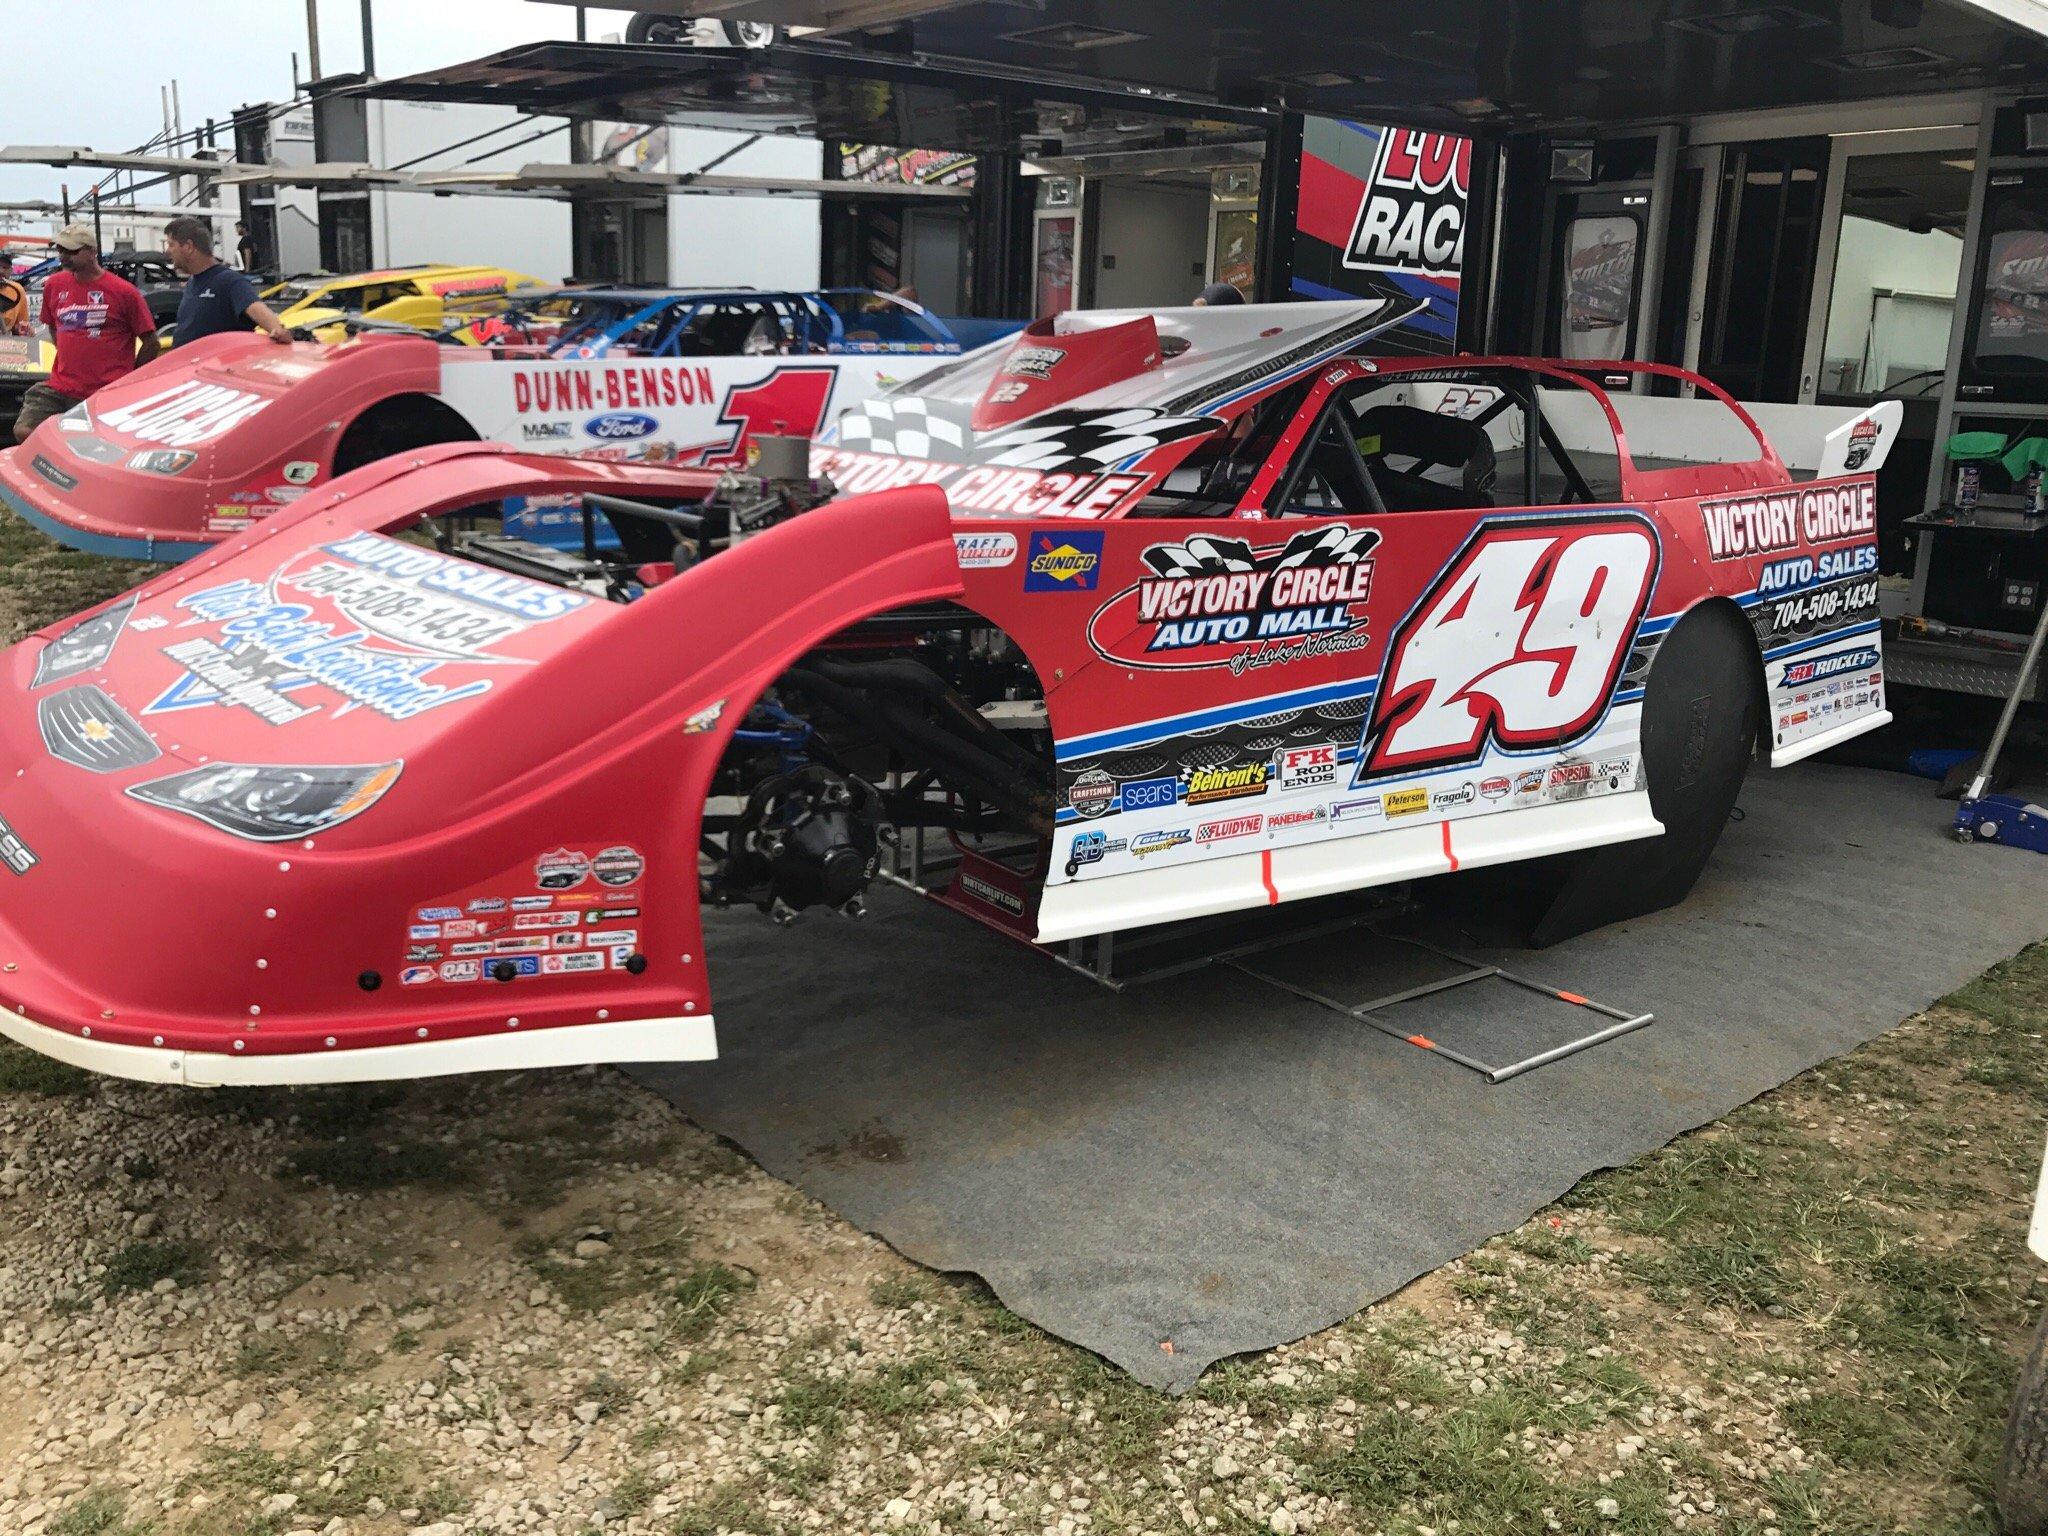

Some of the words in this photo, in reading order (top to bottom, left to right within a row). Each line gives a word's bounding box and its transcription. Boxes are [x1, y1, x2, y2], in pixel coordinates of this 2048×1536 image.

[1355, 196, 1464, 268] RAC
[514, 366, 716, 413] DUNN-BENSON
[97, 380, 275, 447] LUCAS
[596, 413, 647, 438] Ford
[944, 467, 1140, 520] CIRCLE
[1703, 497, 1798, 558] VICTORY
[1803, 484, 1874, 542] CIRCLE
[330, 532, 444, 579] AUTO
[424, 563, 588, 618] SALES
[1034, 554, 1095, 571] SUNOCO
[1759, 557, 1813, 593] AUTO
[1818, 546, 1877, 583] SALES
[292, 565, 512, 648] 704-508-1434
[1140, 572, 1267, 621] VICTORY
[1273, 564, 1373, 606] CIRCLE
[1772, 580, 1878, 630] 704-508-1434
[1152, 617, 1250, 648] AUTO
[1258, 606, 1351, 637] MALL
[1230, 653, 1248, 677] of
[1254, 642, 1296, 664] Lake
[1293, 633, 1369, 663] Norman
[1366, 520, 1656, 768] 49
[1815, 651, 1871, 676] ROCKET
[1286, 747, 1334, 768] FK
[1294, 764, 1335, 777] ROD
[1189, 763, 1267, 794] Behrent's
[1283, 773, 1335, 788] ENDS
[1550, 765, 1591, 786] SIMPSON
[1072, 786, 1112, 799] CRAFTSMAN
[1125, 783, 1173, 807] sears
[1188, 790, 1229, 801] Performance
[1387, 792, 1426, 806] Peterson
[1433, 789, 1471, 806] Fragola
[1210, 818, 1261, 839] FLUIDYNE
